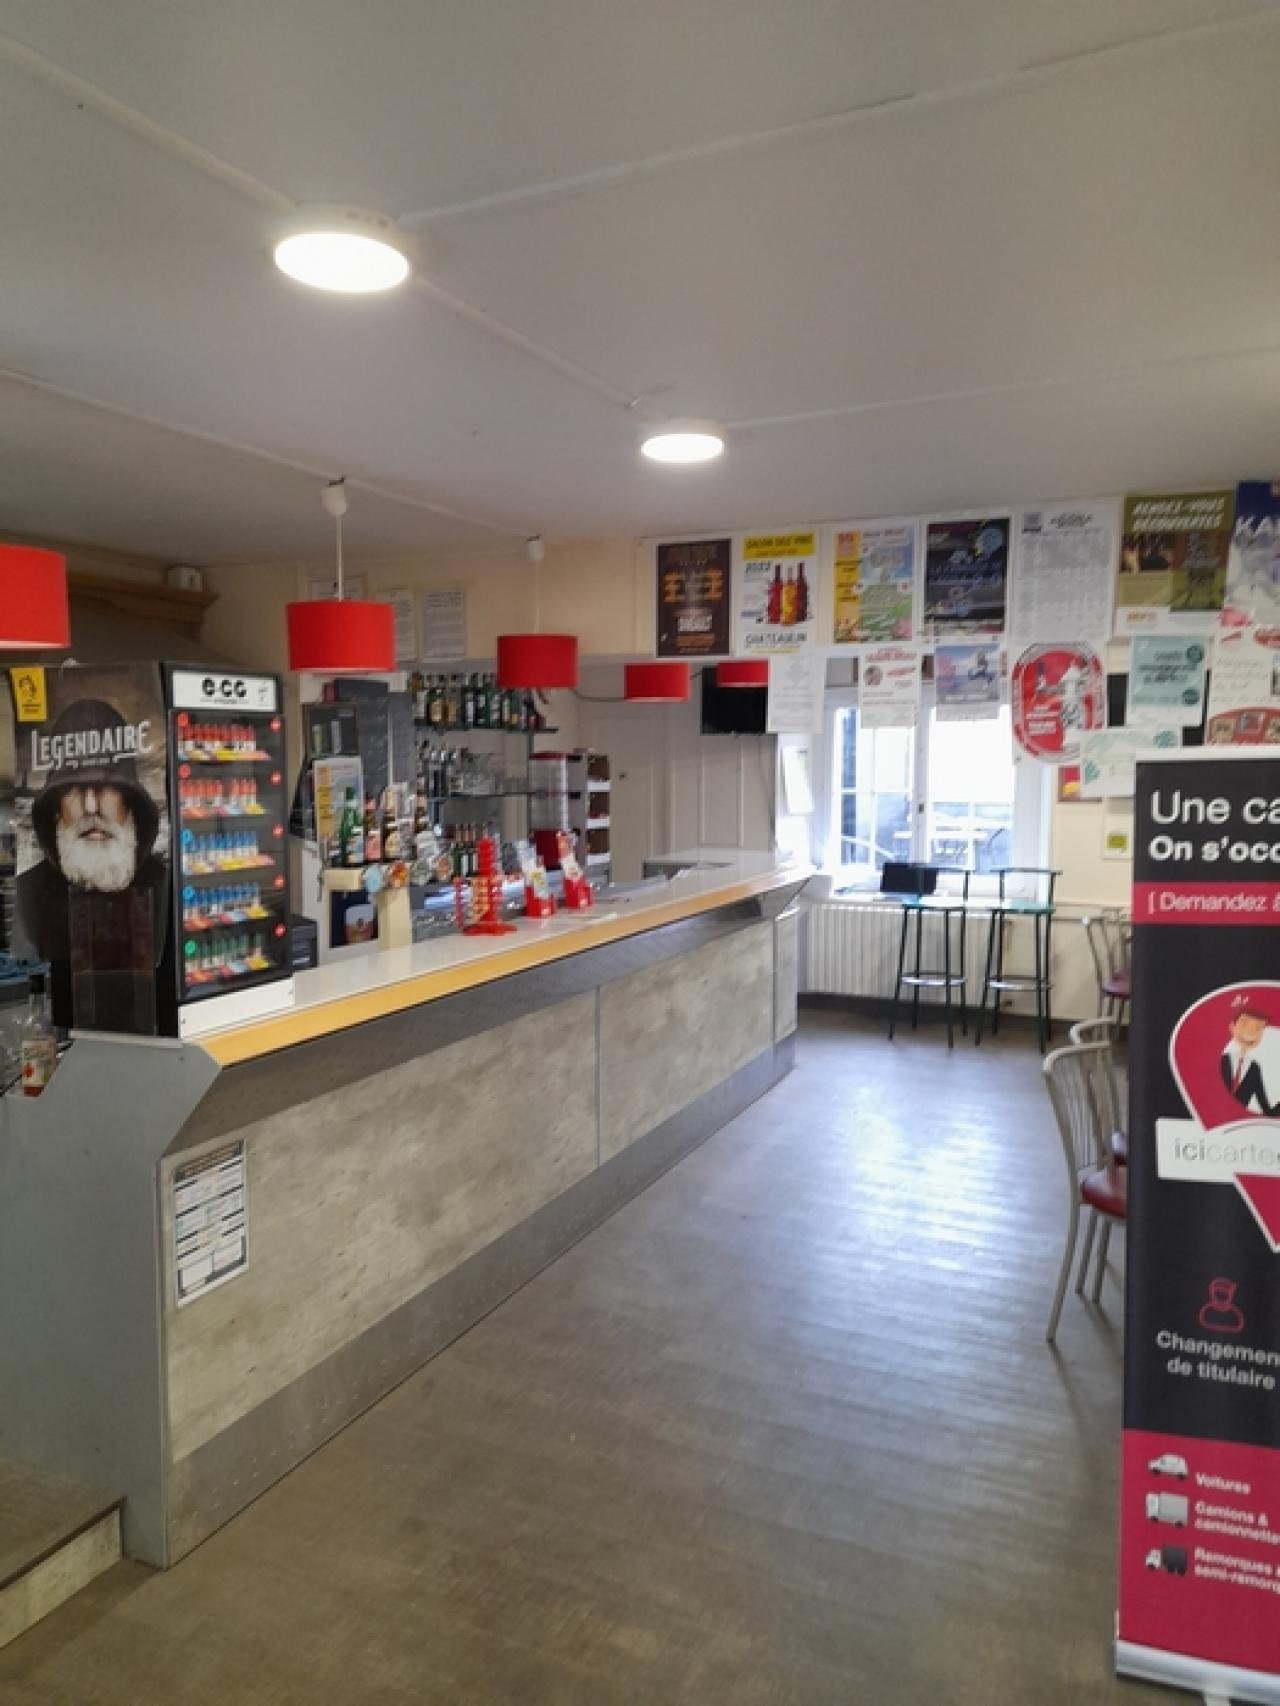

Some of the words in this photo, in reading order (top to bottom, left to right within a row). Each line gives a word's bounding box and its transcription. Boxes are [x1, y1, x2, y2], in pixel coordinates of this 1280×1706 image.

[31, 719, 153, 772] LEGENDAIRE
[1150, 789, 1232, 825] Une
[1148, 834, 1194, 862] On
[1160, 891, 1267, 913] Demandez
[1174, 1138, 1280, 1170] icicarte
[1167, 1356, 1193, 1377] de
[1197, 1361, 1276, 1391] titulaire
[1195, 1471, 1252, 1495] Voitures
[1195, 1500, 1254, 1524] Camions
